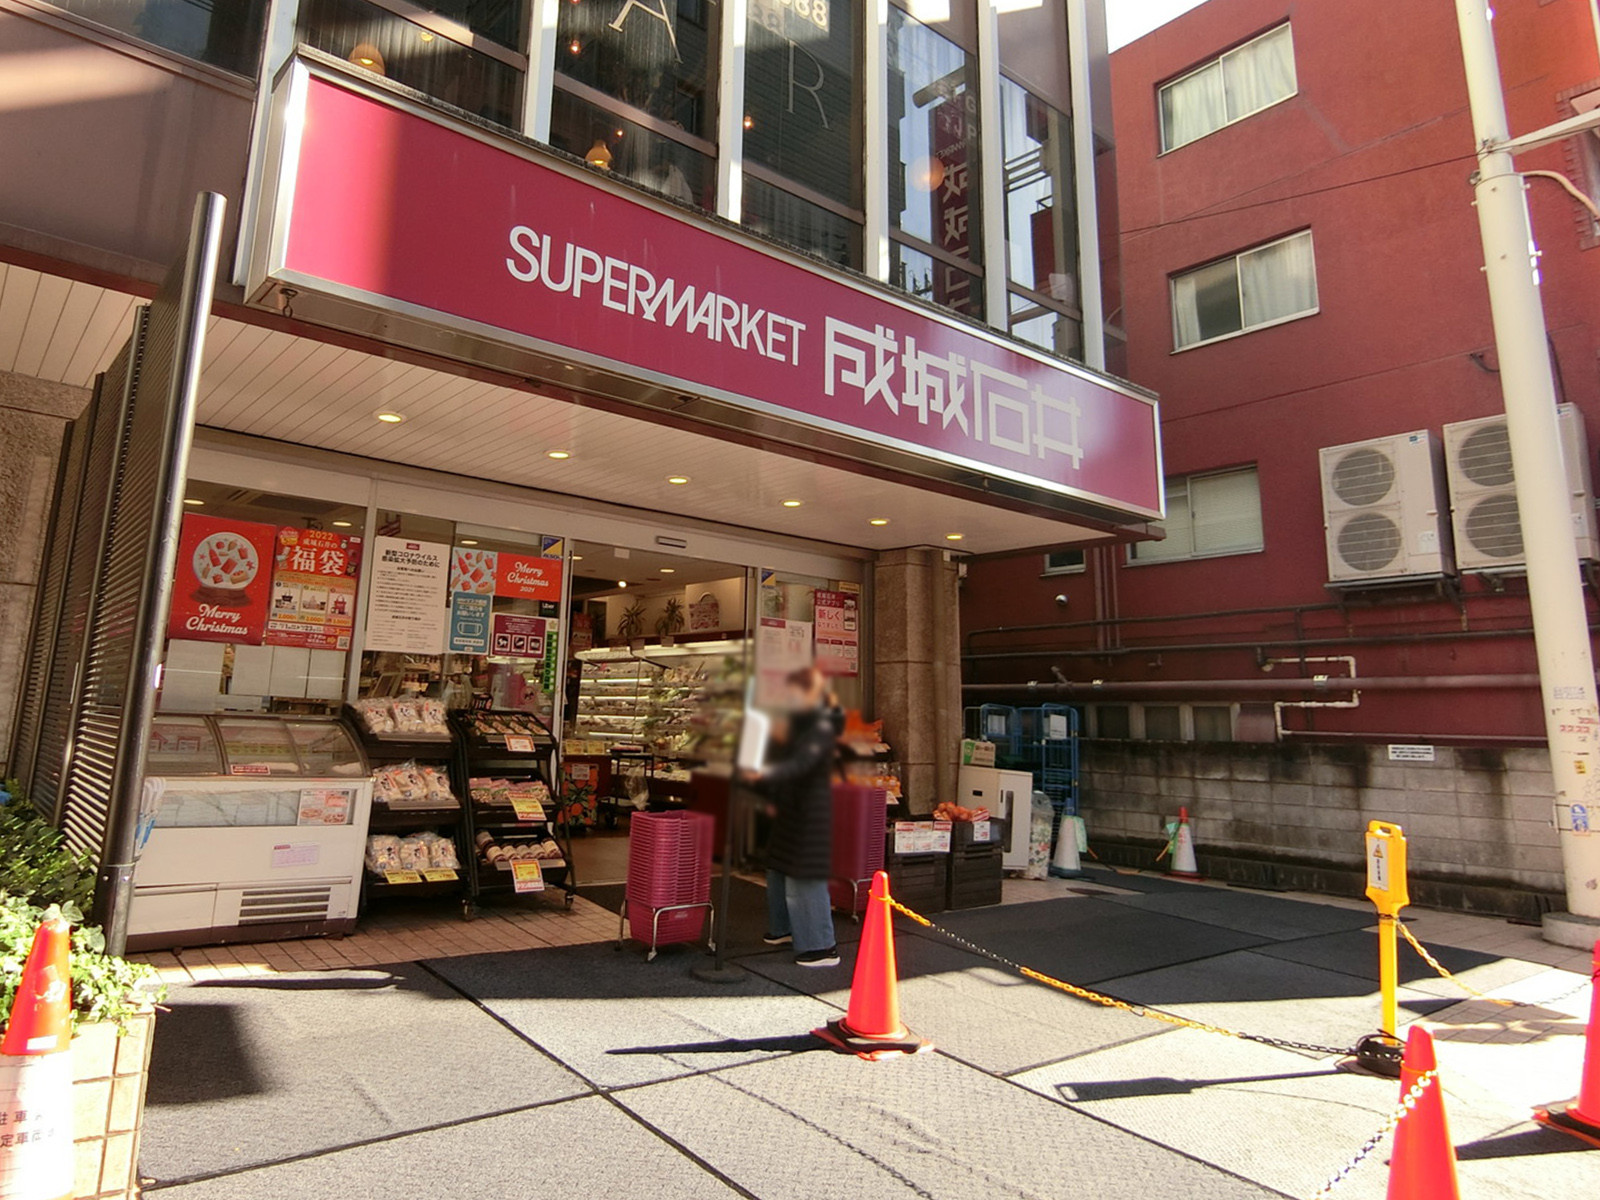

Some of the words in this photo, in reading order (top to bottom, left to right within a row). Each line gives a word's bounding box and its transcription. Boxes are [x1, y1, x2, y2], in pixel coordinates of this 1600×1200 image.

[506, 225, 806, 366] SUPERMARKET
[824, 315, 1084, 470] 成城石井
[309, 530, 334, 541] 2022
[291, 545, 345, 576] 福袋
[514, 561, 544, 577] Merry
[506, 571, 549, 587] Christmas
[199, 603, 242, 624] Merry
[185, 615, 249, 635] Christmas
